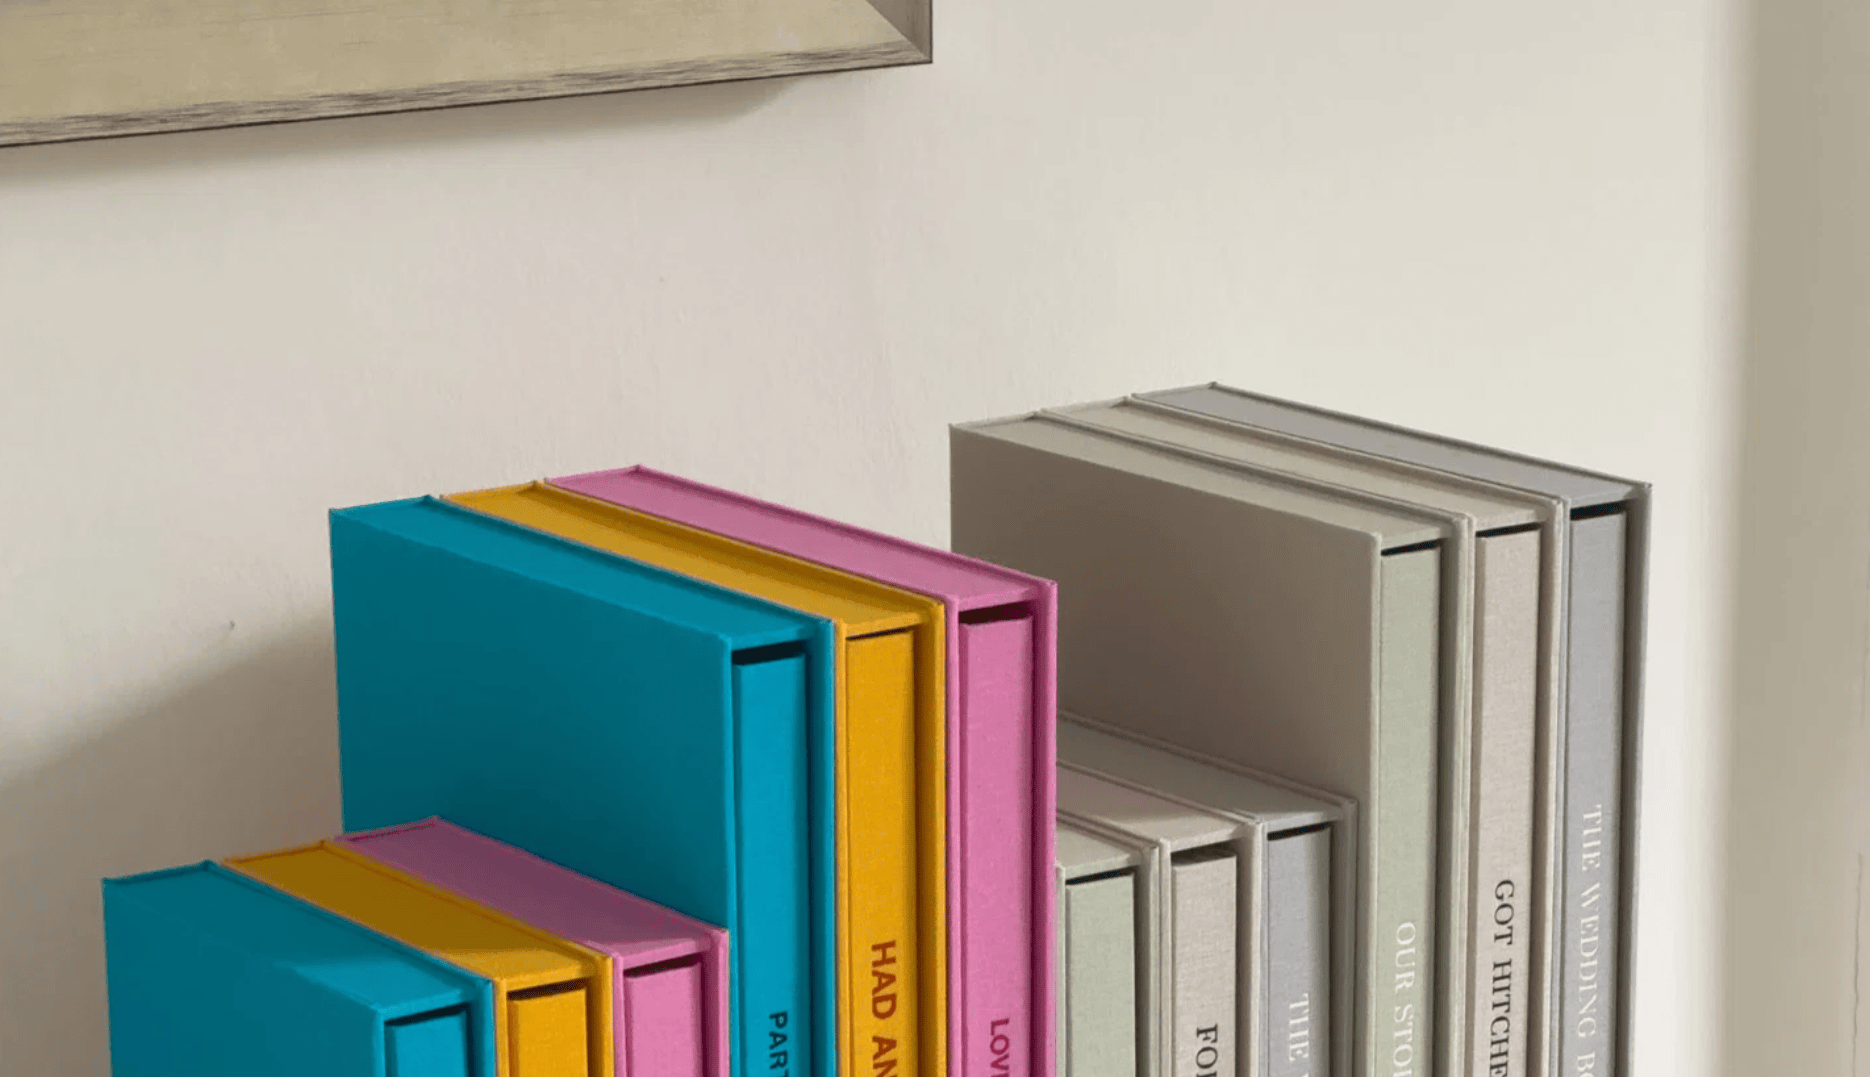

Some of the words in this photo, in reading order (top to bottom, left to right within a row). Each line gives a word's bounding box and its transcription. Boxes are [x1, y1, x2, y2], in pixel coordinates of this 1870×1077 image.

[1581, 804, 1602, 871] THE
[1494, 879, 1515, 945] GOT
[871, 939, 897, 1021] HAD
[1395, 921, 1416, 993] OUR
[1577, 882, 1601, 1039] WEDDING
[1288, 992, 1310, 1062] THE
